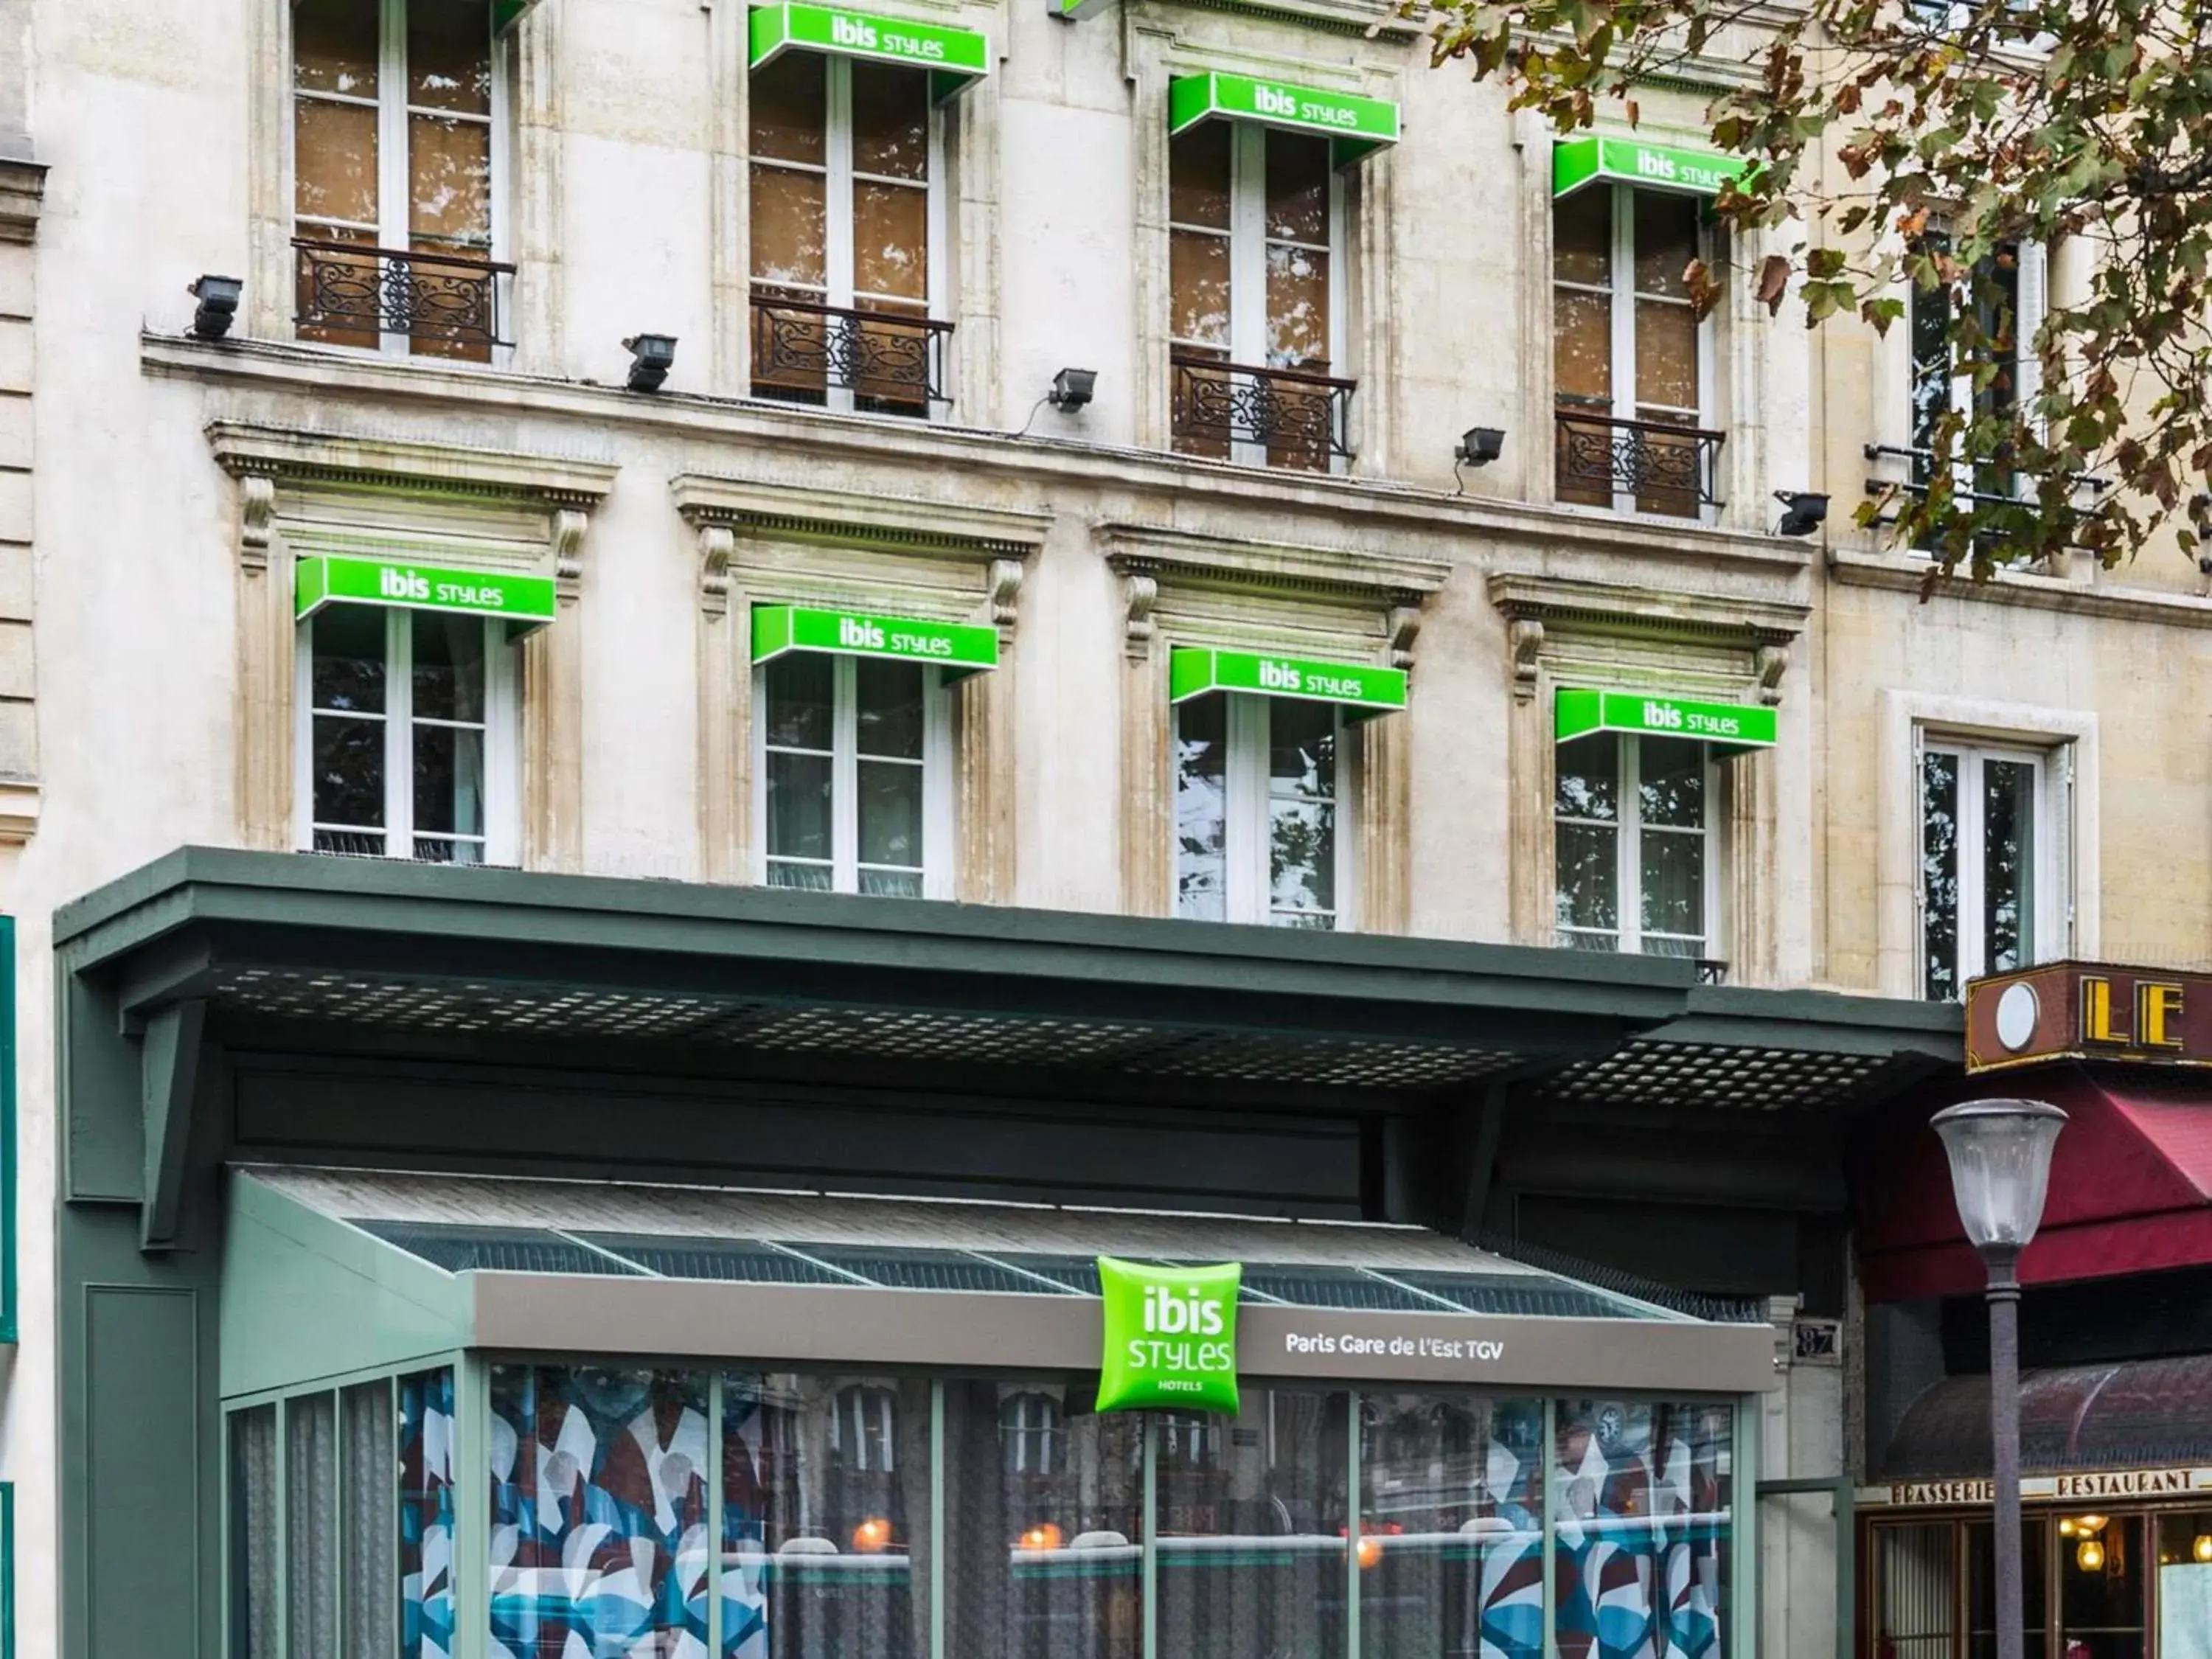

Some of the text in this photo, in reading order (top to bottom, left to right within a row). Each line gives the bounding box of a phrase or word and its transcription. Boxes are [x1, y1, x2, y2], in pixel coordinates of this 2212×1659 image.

[832, 14, 877, 49] ibis
[1254, 83, 1296, 116] ibis
[1637, 147, 1676, 178] ibis
[380, 566, 431, 599] ibis
[839, 616, 886, 649] ibis
[1259, 658, 1301, 690] ibis
[1643, 700, 1682, 728] ibis
[2079, 975, 2183, 1051] LE
[1144, 1286, 1223, 1335] ibis
[1285, 1332, 1504, 1361] Paris Gare de l'Est TGV
[1158, 1380, 1203, 1391] HOTELS
[1891, 1471, 2191, 1505] BRASSERIE RESTAURANT
